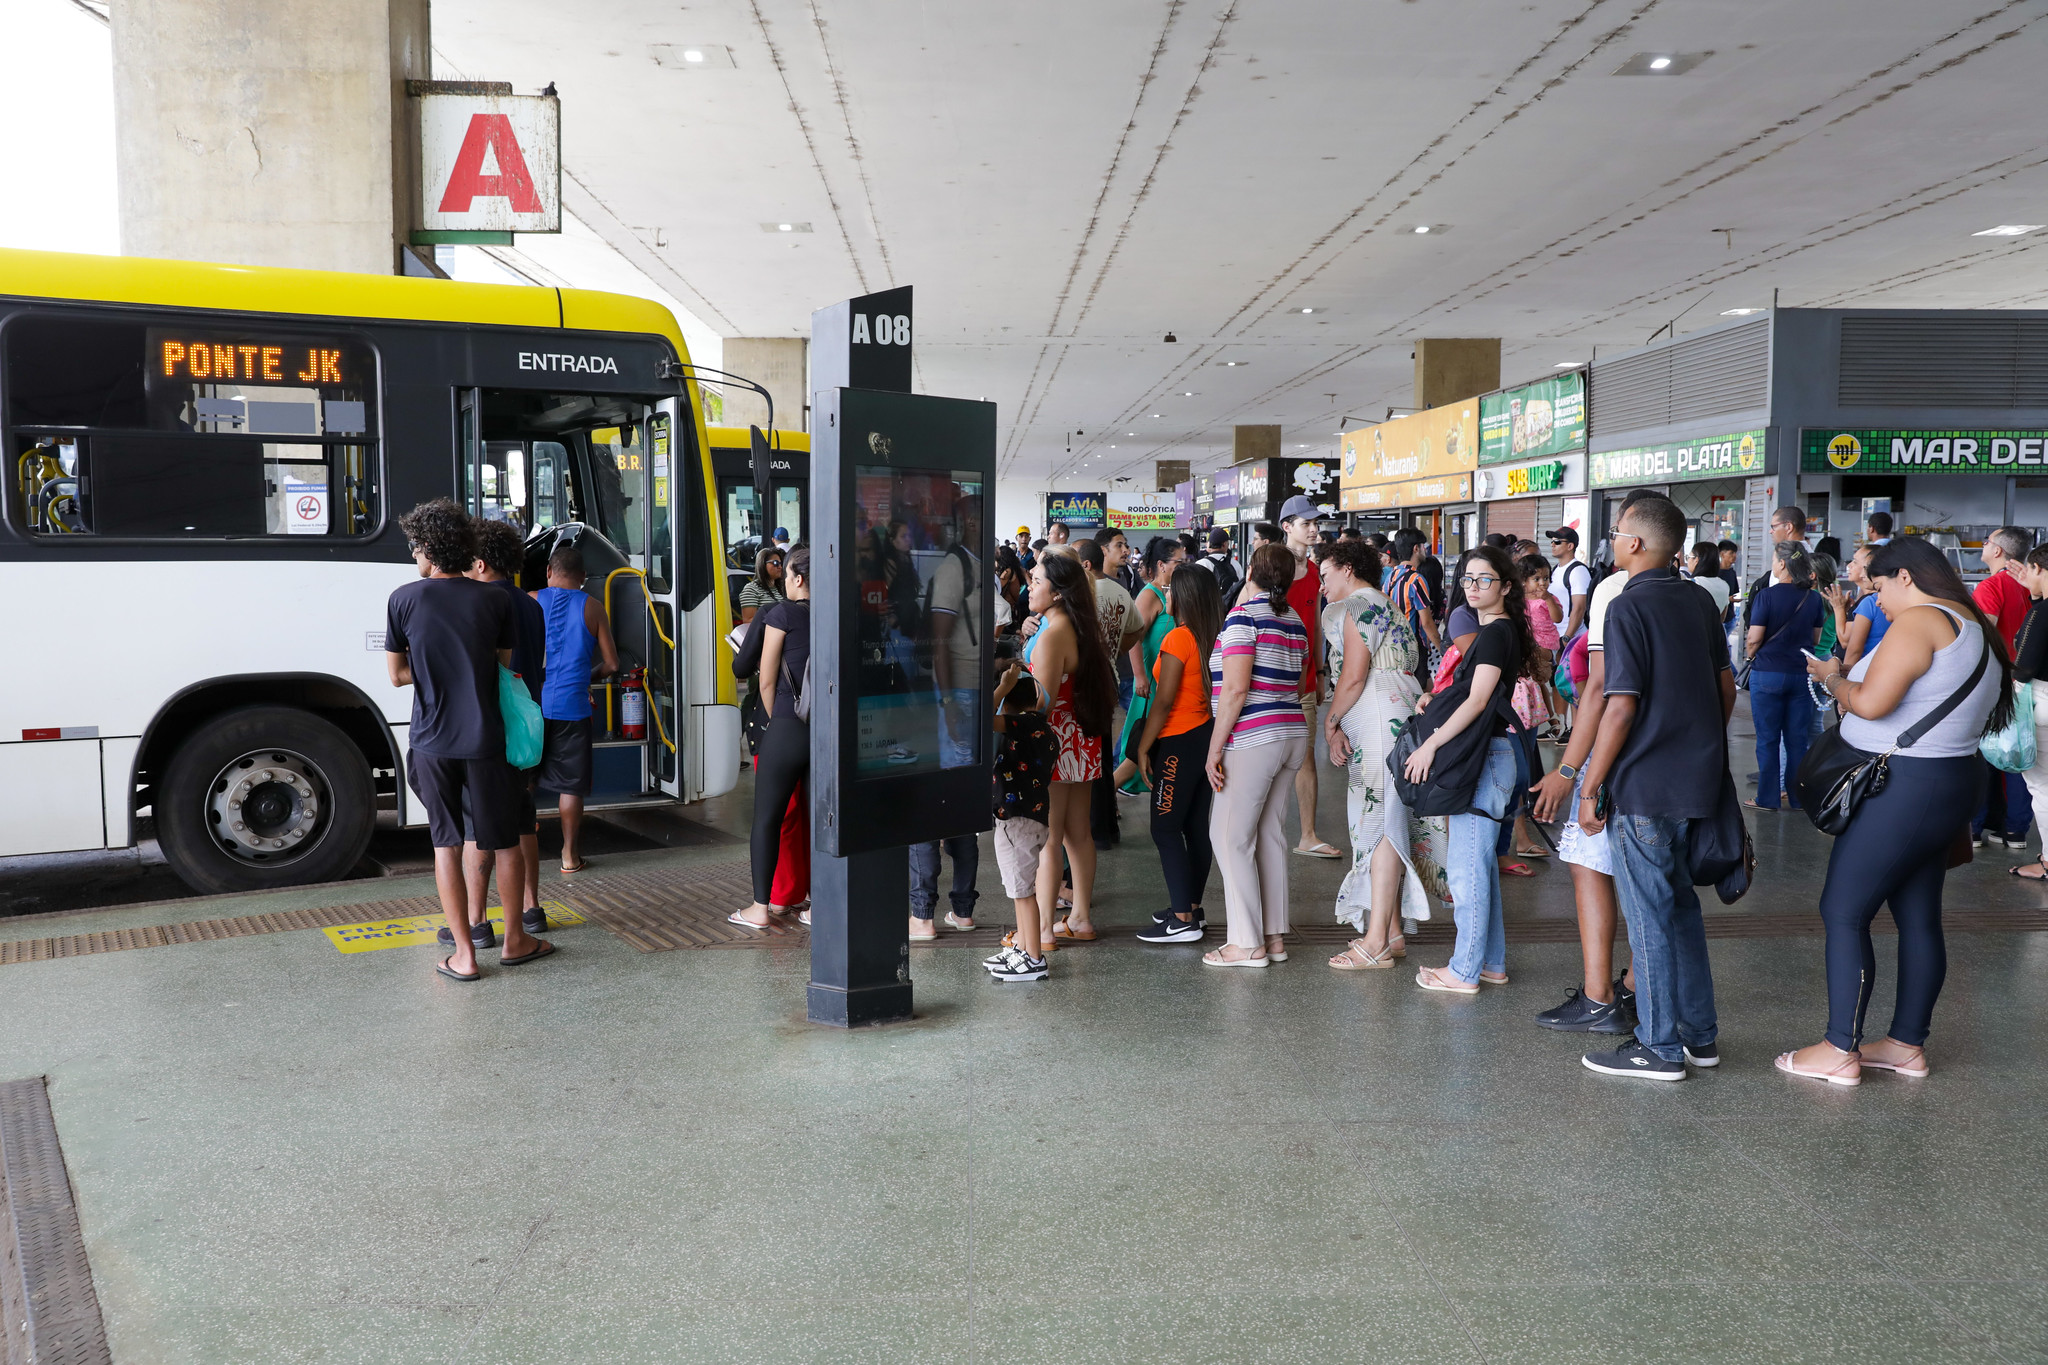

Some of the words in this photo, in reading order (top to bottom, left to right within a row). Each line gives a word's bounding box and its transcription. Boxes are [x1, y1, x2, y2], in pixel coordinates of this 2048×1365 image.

[438, 114, 545, 213] A
[852, 313, 871, 344] A
[875, 313, 910, 346] 08
[164, 342, 282, 380] PONTE
[299, 349, 342, 383] JK
[518, 352, 619, 375] ENTRADA
[748, 459, 791, 470] EADA
[1381, 450, 1419, 478] Naturanja
[1610, 454, 1640, 479] MAR
[1644, 450, 1673, 476] DEL
[1677, 441, 1732, 473] PLATA
[1891, 437, 1980, 466] MAR
[1989, 437, 2048, 466] DE
[1507, 461, 1564, 496] SUBWAY
[1108, 513, 1132, 521] EXAME
[1151, 503, 1176, 513] ÓTICA
[1239, 505, 1265, 521] VITAMINAS
[867, 591, 882, 604] G1
[1162, 755, 1179, 782] Neto
[1157, 784, 1174, 816] Vasco
[337, 922, 402, 936] FILA
